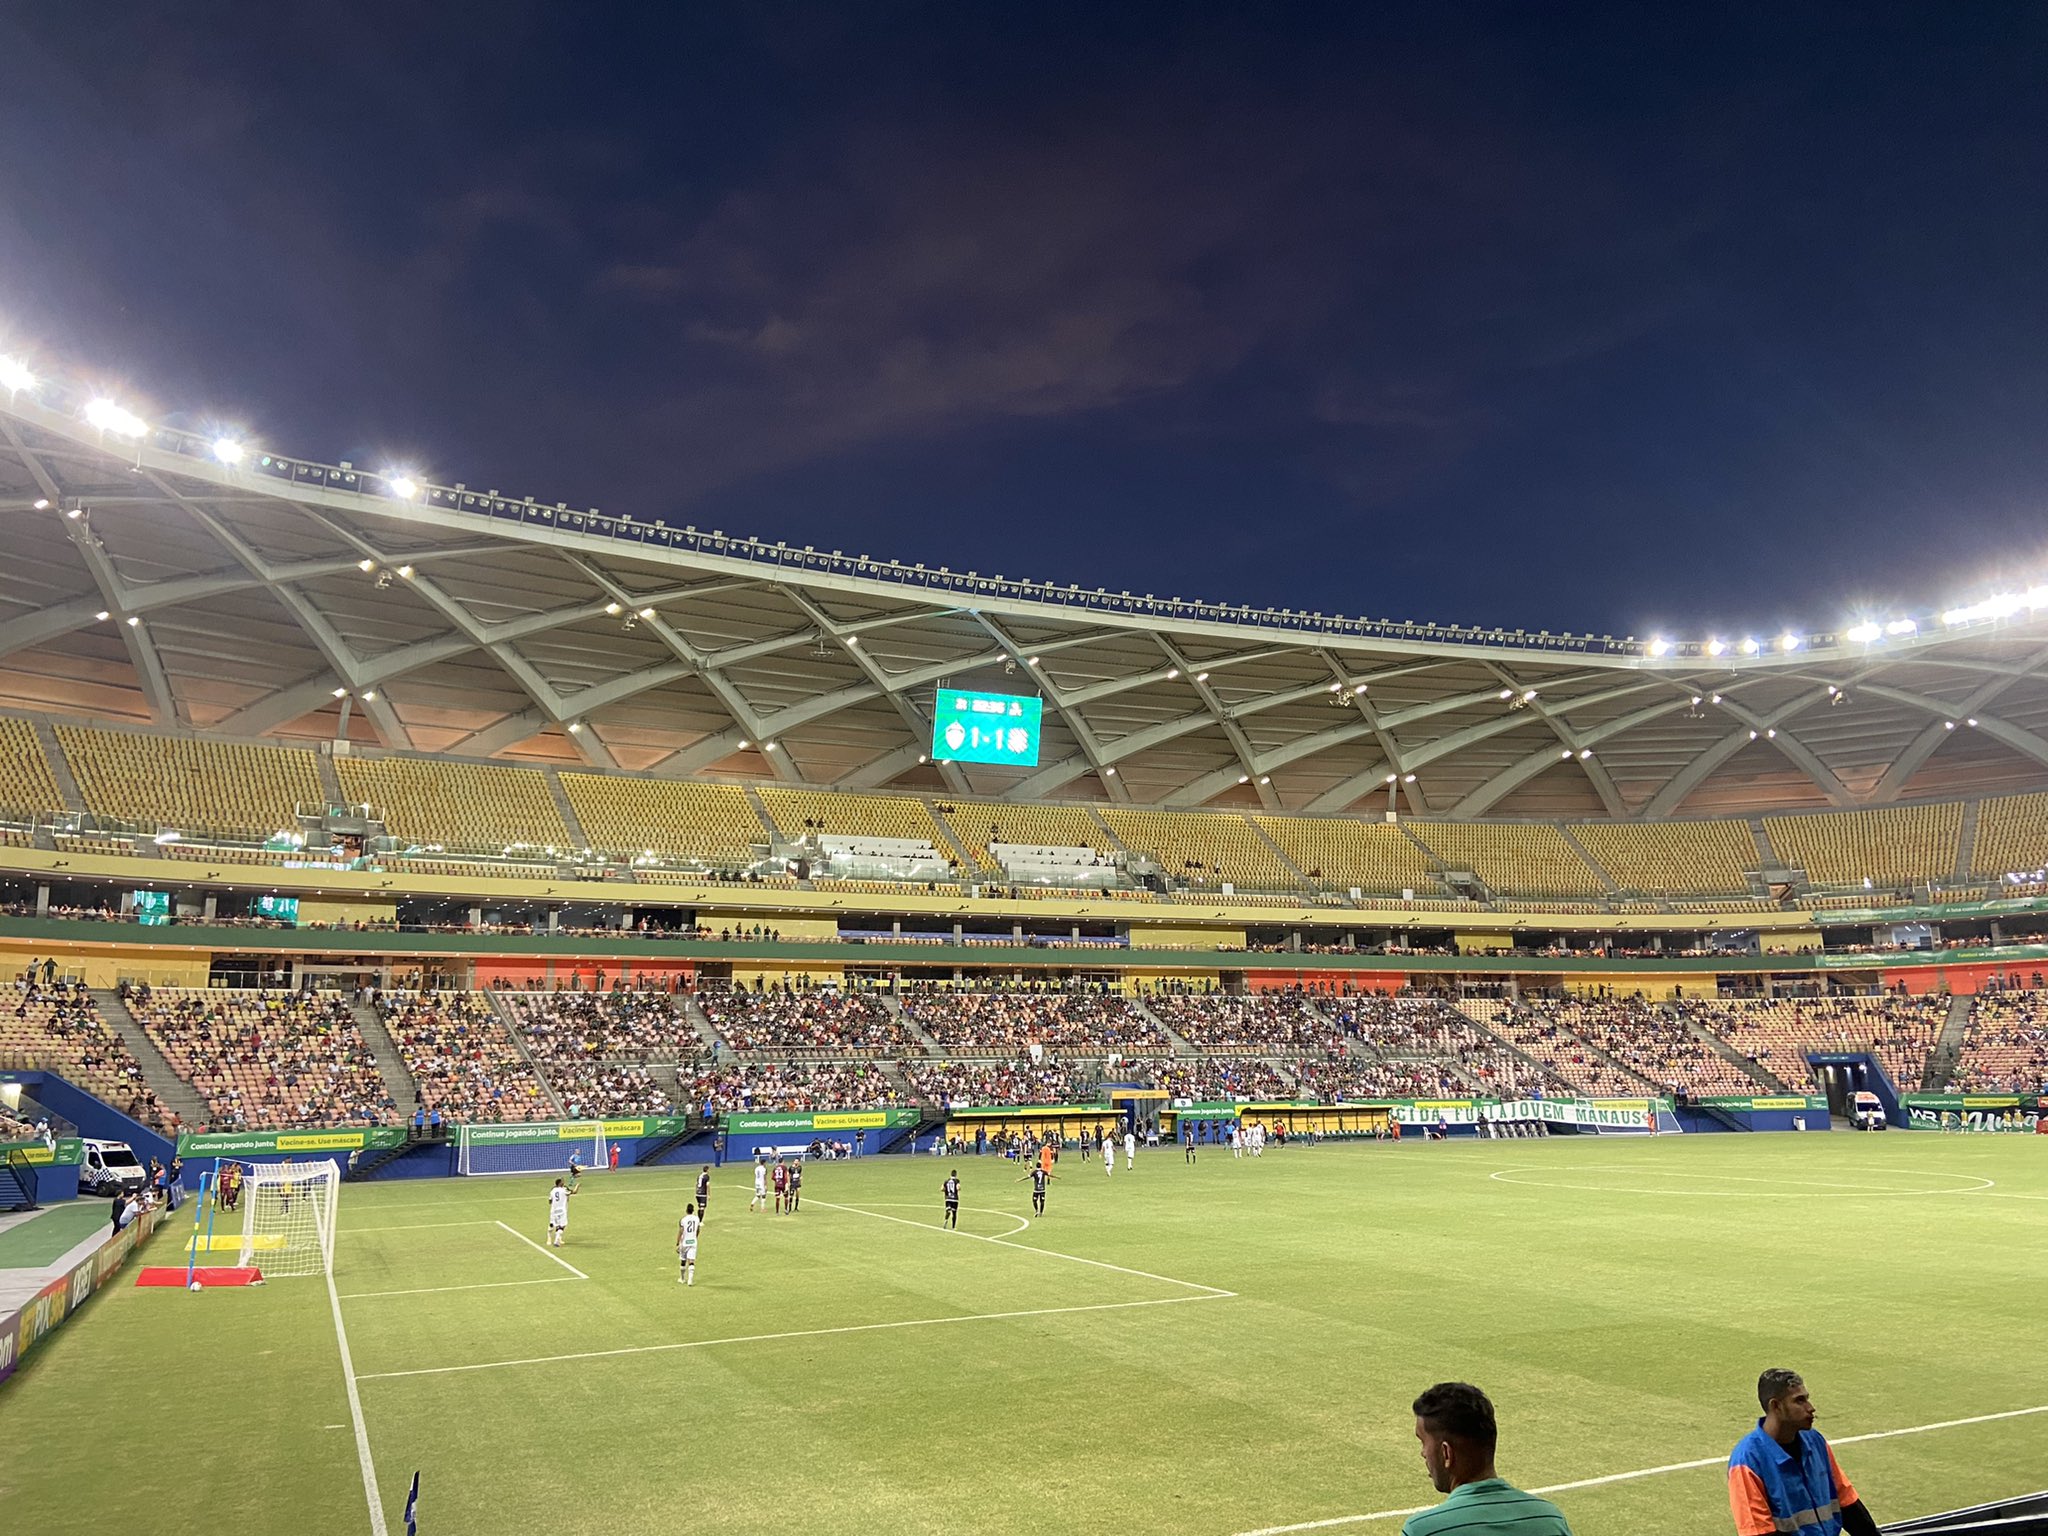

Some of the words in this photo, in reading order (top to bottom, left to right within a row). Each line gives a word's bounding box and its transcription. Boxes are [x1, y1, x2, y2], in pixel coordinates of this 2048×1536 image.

[1575, 1108, 1641, 1124] MANAUS
[739, 1120, 768, 1128] Continue
[768, 1119, 795, 1128] jogando
[471, 1131, 505, 1139] Continue
[505, 1129, 537, 1138] jogando
[190, 1142, 222, 1150] Continue
[223, 1141, 254, 1150] jogando
[254, 1140, 276, 1149] junto.
[554, 1191, 560, 1201] 9
[687, 1220, 695, 1233] 21
